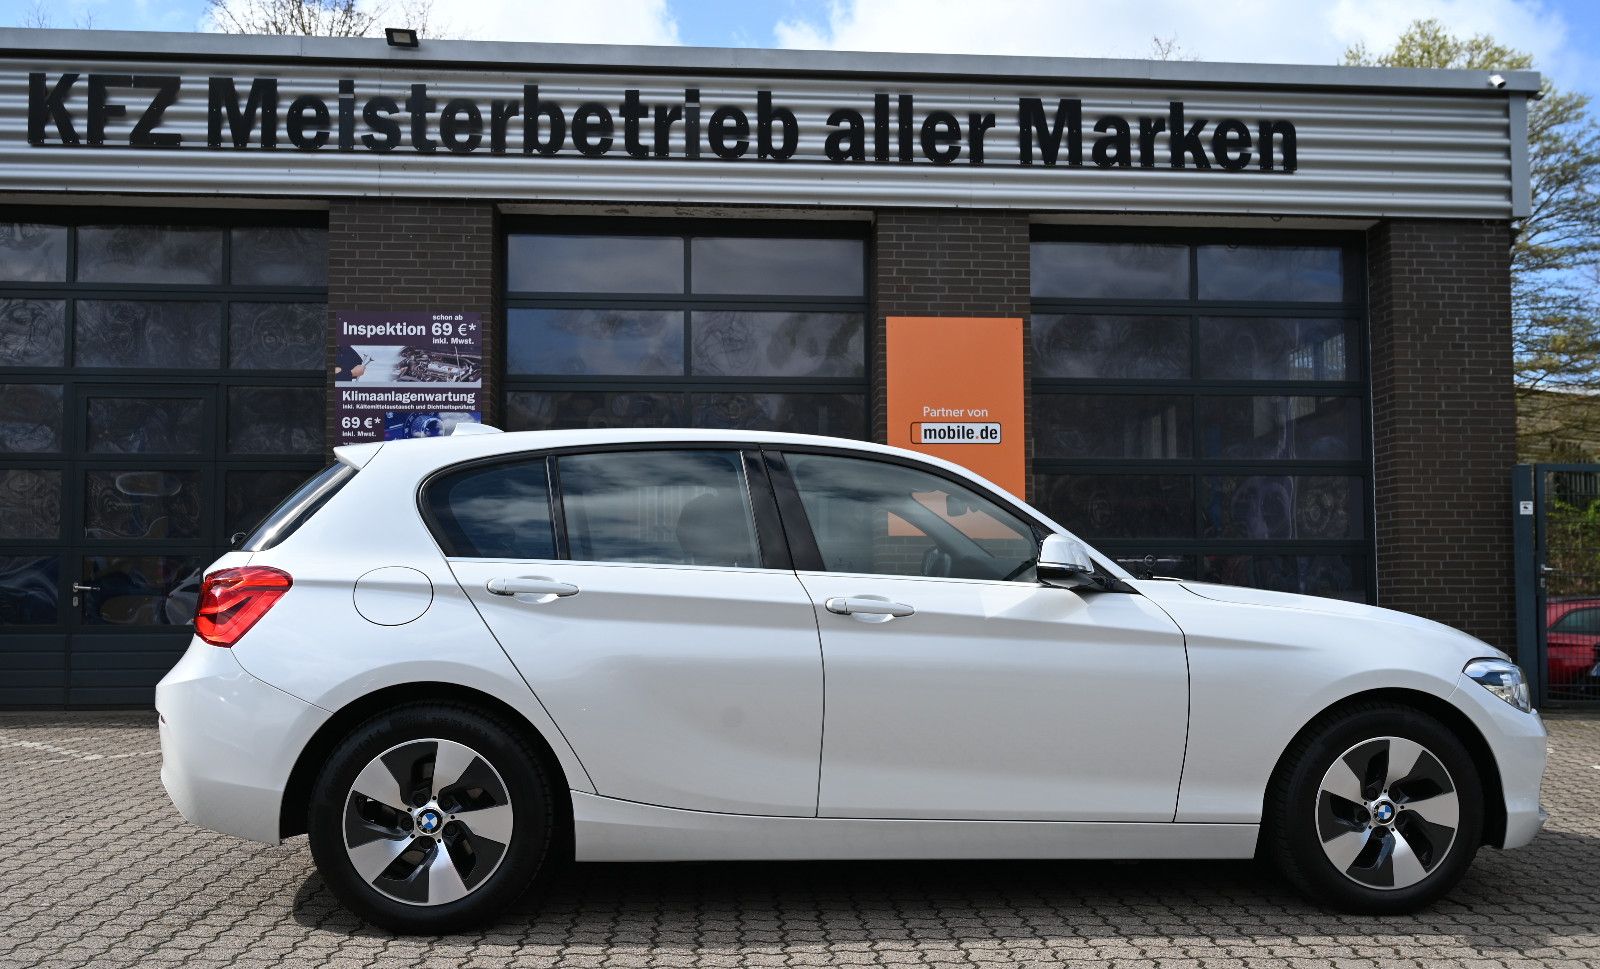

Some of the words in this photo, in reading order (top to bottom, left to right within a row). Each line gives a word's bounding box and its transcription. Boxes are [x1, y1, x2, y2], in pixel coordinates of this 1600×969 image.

[28, 73, 181, 146] KFZ
[208, 77, 798, 161] Meisterbetrieb
[825, 93, 995, 164] aller
[1019, 98, 1297, 172] Marken
[343, 322, 426, 338] Inspektion
[431, 322, 453, 336] 69
[432, 337, 449, 345] inkl.
[450, 337, 475, 345] Mwst.
[342, 390, 476, 404] Klimaanlagenwartung
[923, 406, 965, 417] Partner
[967, 409, 989, 417] von
[341, 416, 361, 429] 69
[923, 425, 998, 440] mobile.de
